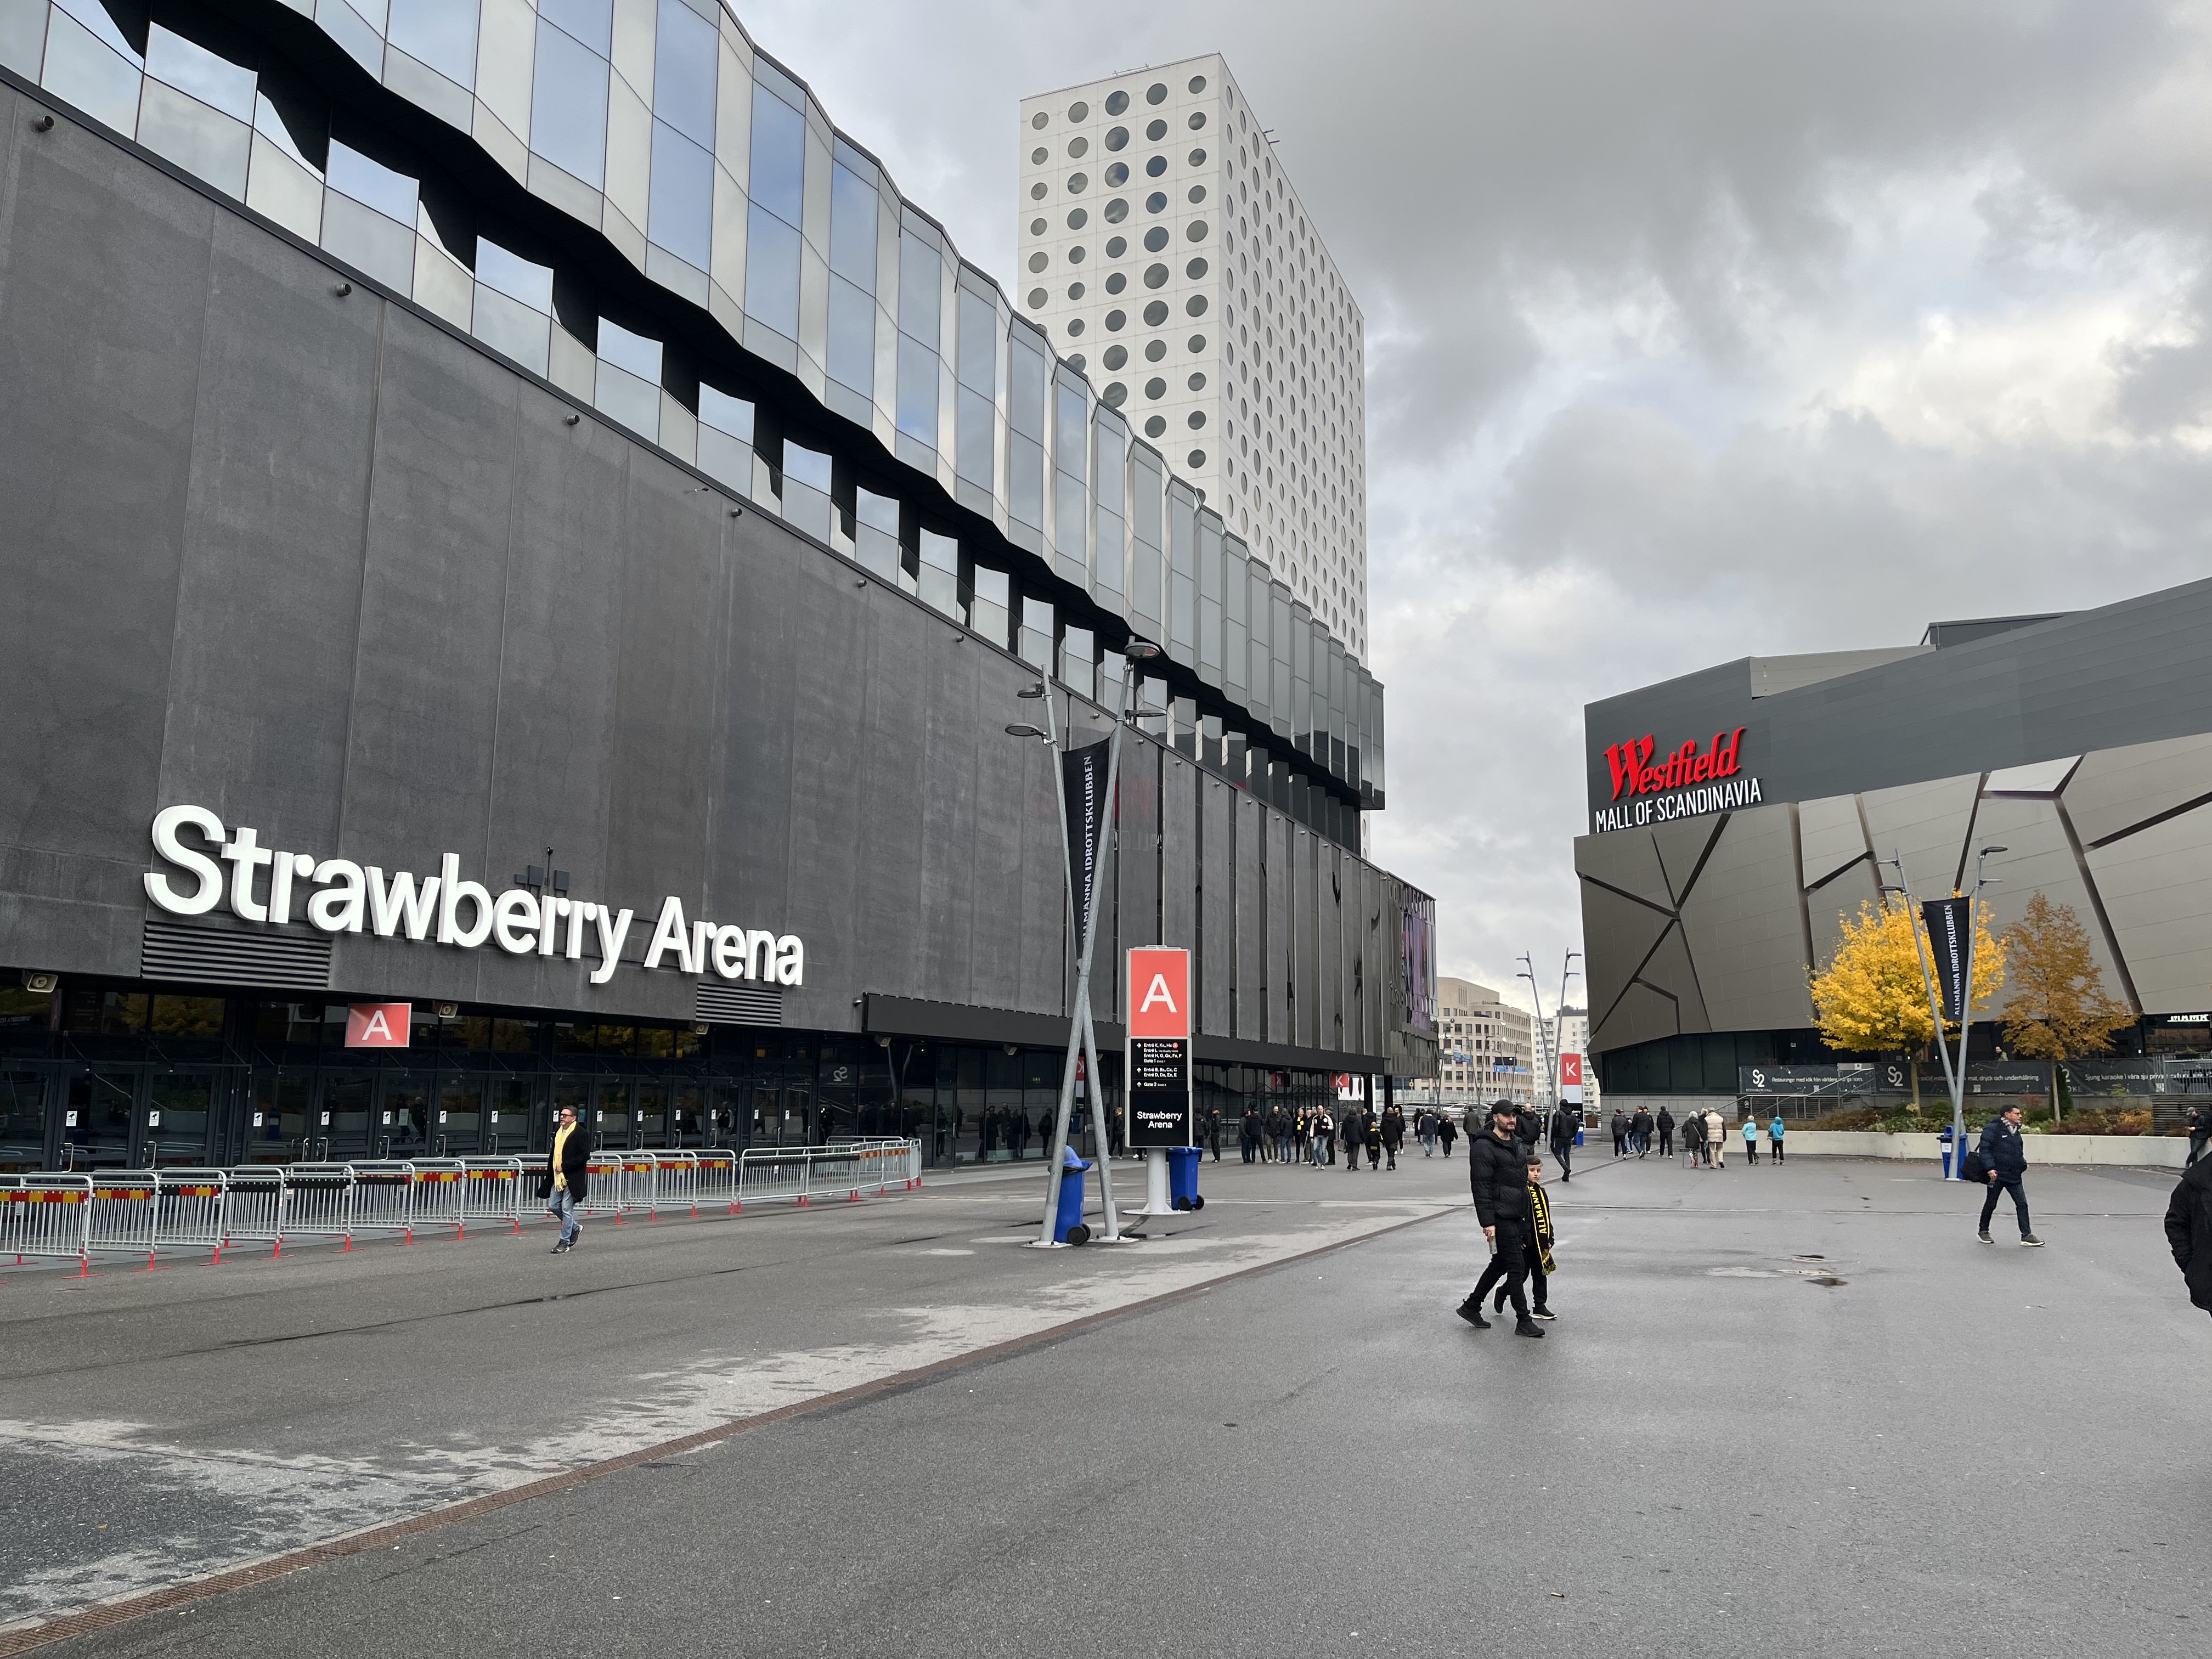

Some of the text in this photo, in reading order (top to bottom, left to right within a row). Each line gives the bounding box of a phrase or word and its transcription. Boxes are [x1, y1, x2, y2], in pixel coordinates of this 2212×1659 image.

[1603, 726, 1746, 802] Westfield
[1084, 755, 1093, 871] IDROTTSKLUBBEN
[1595, 777, 1762, 833] MALL OF SCANDINAVIA
[143, 804, 804, 986] Strawberry Arena
[1944, 905, 1959, 972] IDROTTSKLUBBEN
[1140, 973, 1177, 1013] A
[362, 1009, 393, 1042] A
[1335, 1075, 1344, 1086] K
[1566, 1062, 1577, 1076] K
[1752, 1069, 1765, 1087] S2
[1888, 1066, 1903, 1086] S2
[1137, 1111, 1182, 1121] Strawberry
